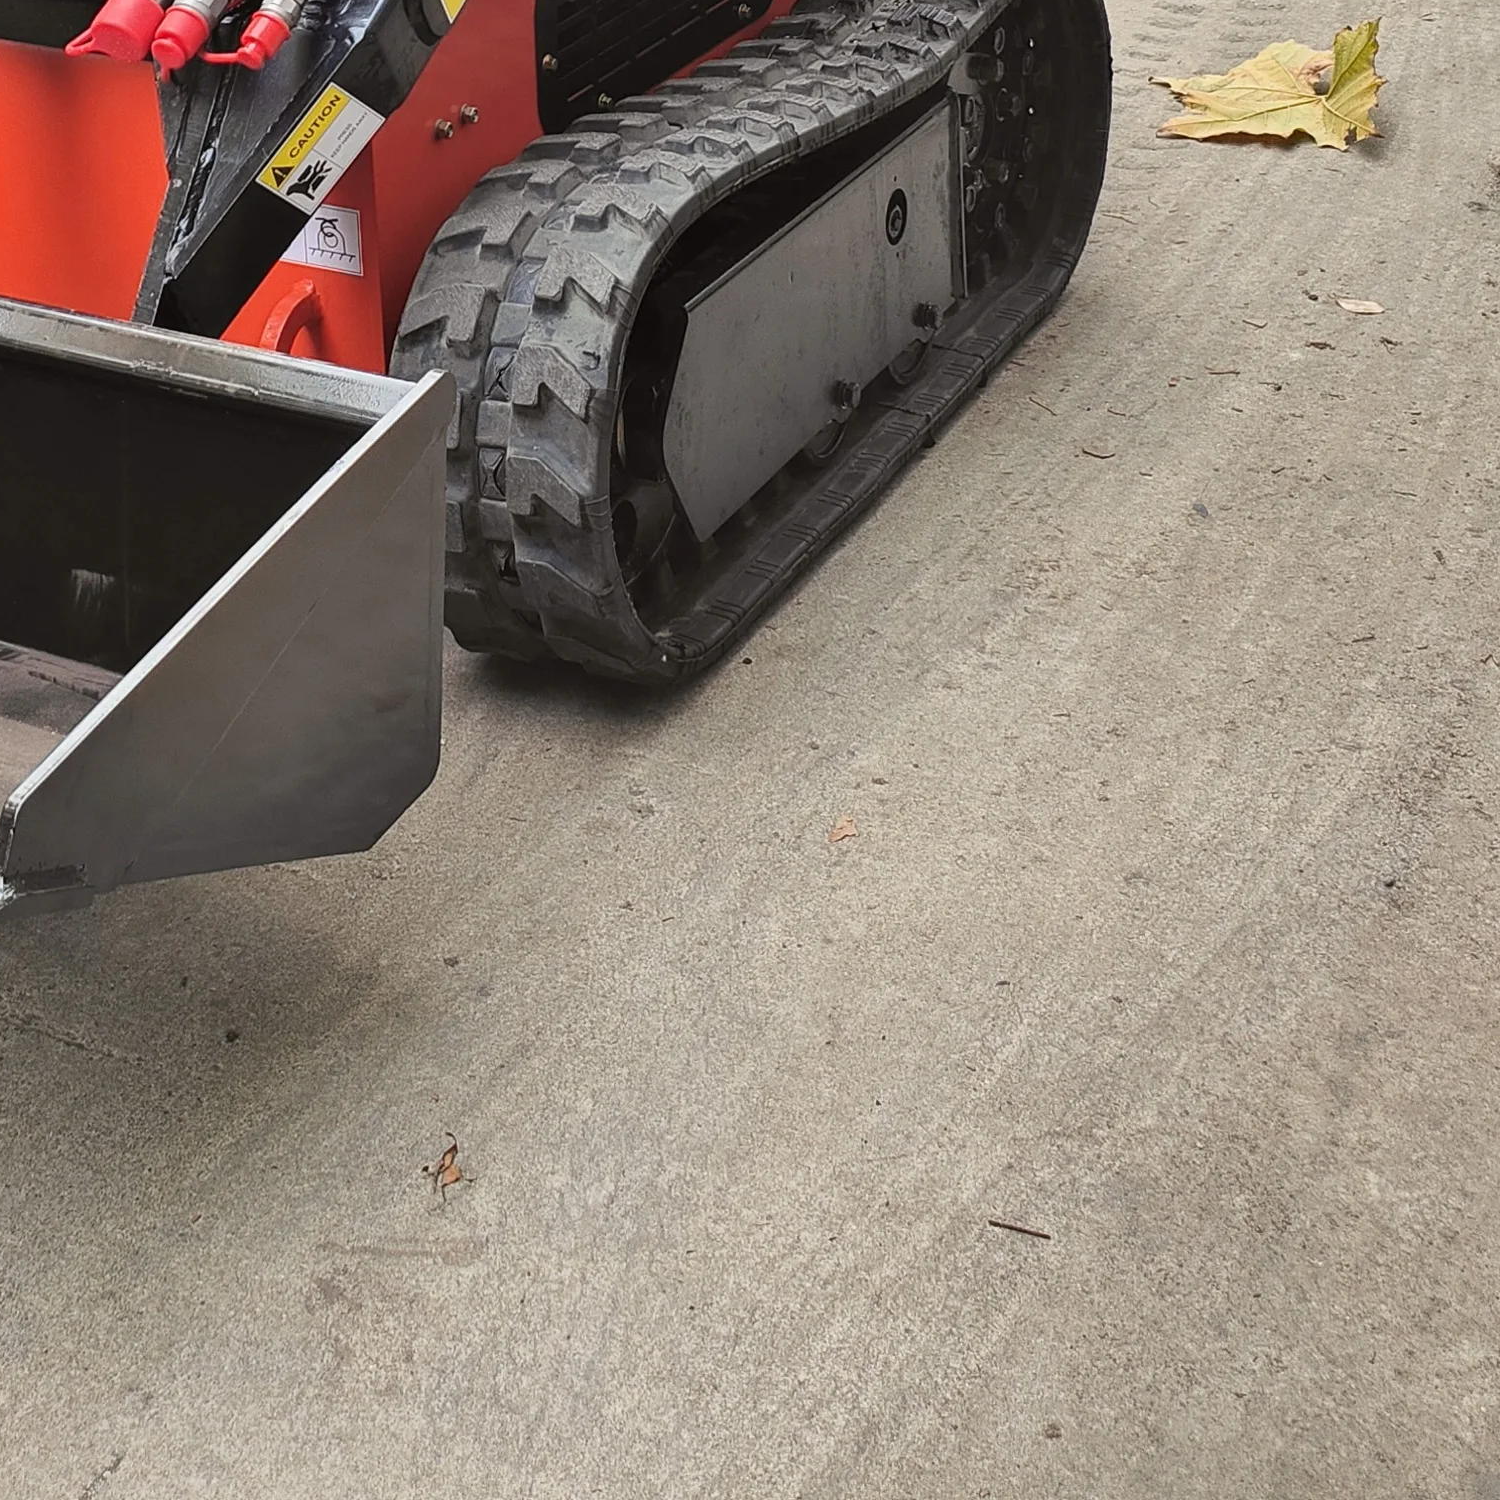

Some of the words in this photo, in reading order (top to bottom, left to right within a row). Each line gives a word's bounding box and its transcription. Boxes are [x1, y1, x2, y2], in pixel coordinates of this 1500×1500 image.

[289, 94, 341, 158] CAUTION
[330, 143, 342, 159] KEEP
[341, 126, 357, 145] HANDS
[355, 111, 368, 127] AWAY
